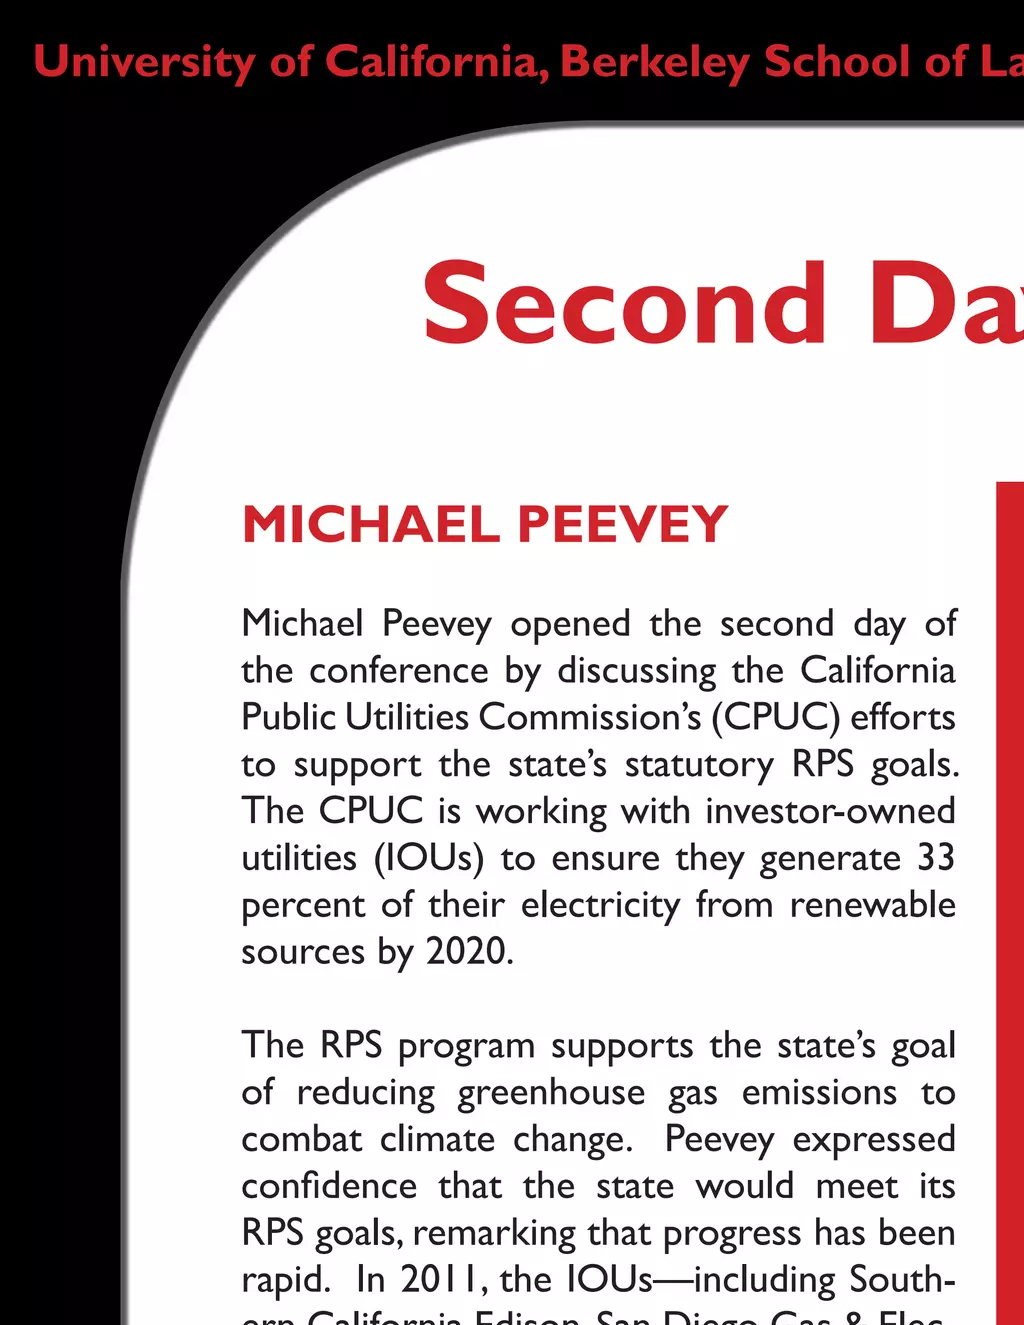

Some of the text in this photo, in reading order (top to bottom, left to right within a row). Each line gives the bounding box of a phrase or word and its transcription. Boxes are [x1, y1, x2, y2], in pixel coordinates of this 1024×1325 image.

[36, 44, 256, 86] University
[271, 44, 314, 76] of
[326, 44, 548, 84] California,
[562, 44, 750, 86] Berkeley
[766, 44, 908, 76] School
[926, 44, 969, 76] of
[425, 259, 824, 344] Second
[245, 505, 728, 542] MICHAEL PEEVEY
[243, 607, 959, 646] Michael Peevey opened the second day of
[243, 701, 956, 740] Public Utilities Commission’s (CPUC) efforts
[241, 794, 955, 833] The CPUC is working with investor-owned
[242, 888, 956, 927] percent of their electricity from renewable
[241, 1029, 955, 1068] The RPS program supports the state’s goal
[243, 1216, 955, 1255] RPS goals, remarking that progress has been
